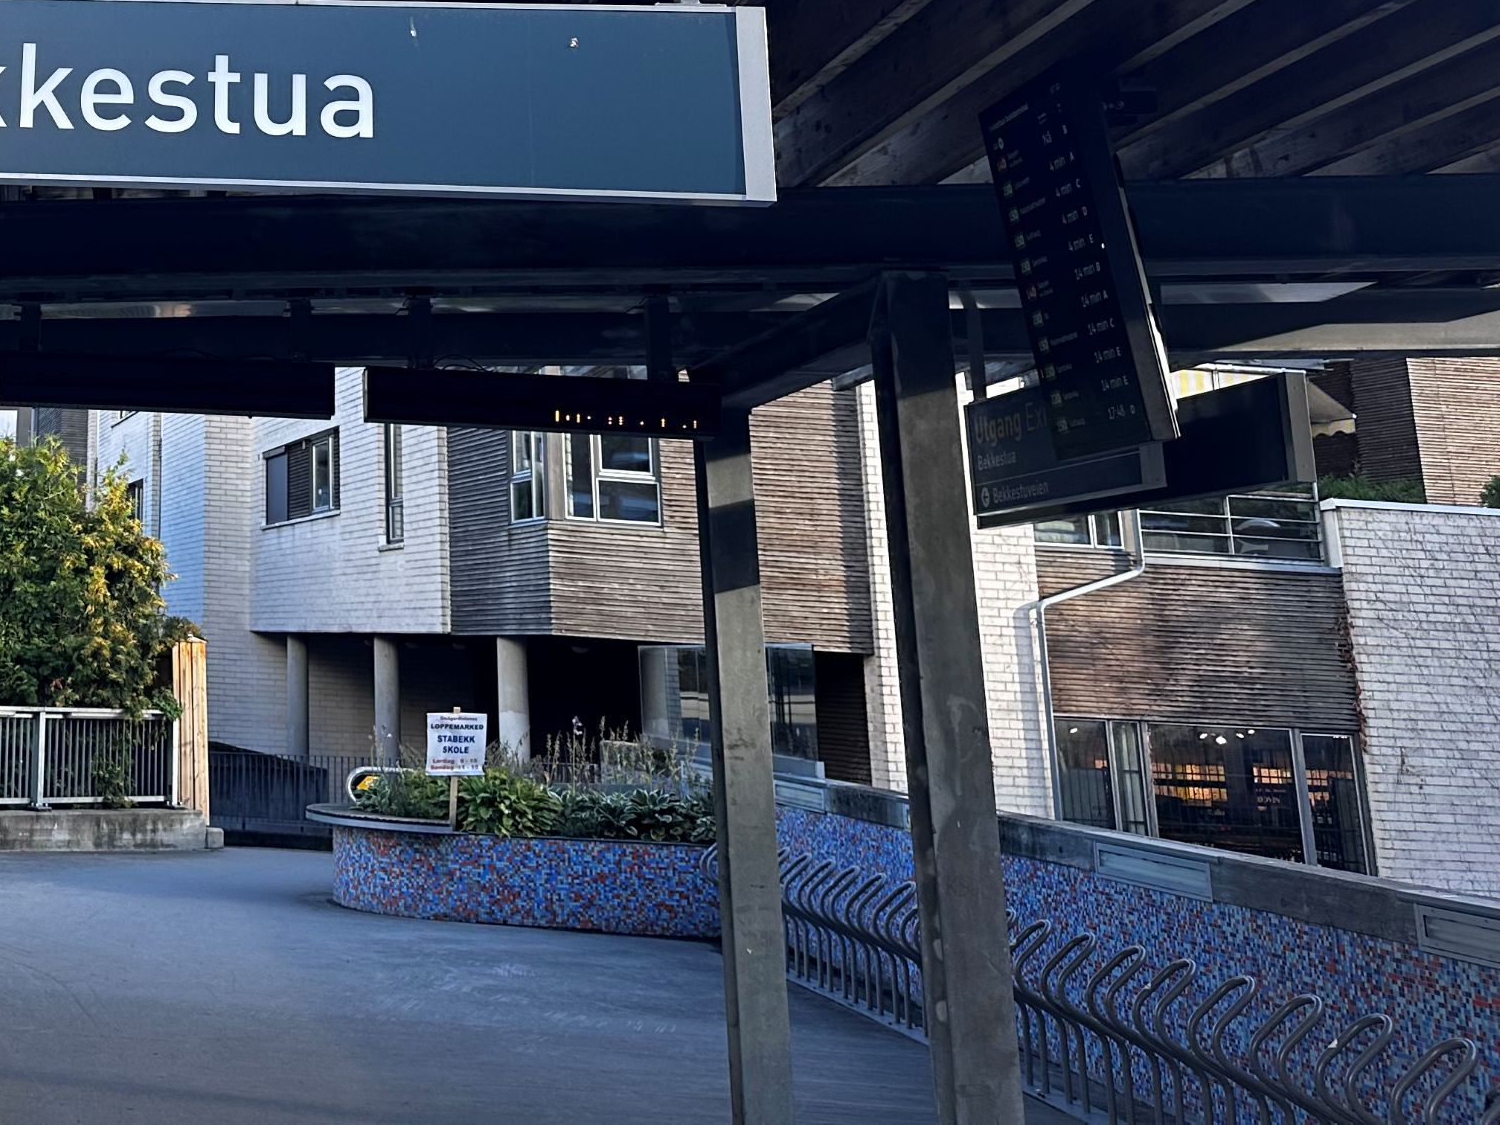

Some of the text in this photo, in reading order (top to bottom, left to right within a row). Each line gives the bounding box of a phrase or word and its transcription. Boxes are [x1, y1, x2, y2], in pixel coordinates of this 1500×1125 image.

[975, 402, 1048, 447] Utgang Exi
[977, 450, 1017, 472] Bekkestua
[992, 481, 1049, 505] Bekkestuveien
[430, 723, 484, 731] LOPPEMARKED
[437, 734, 476, 744] STABEKK
[442, 745, 470, 755] SKOLE
